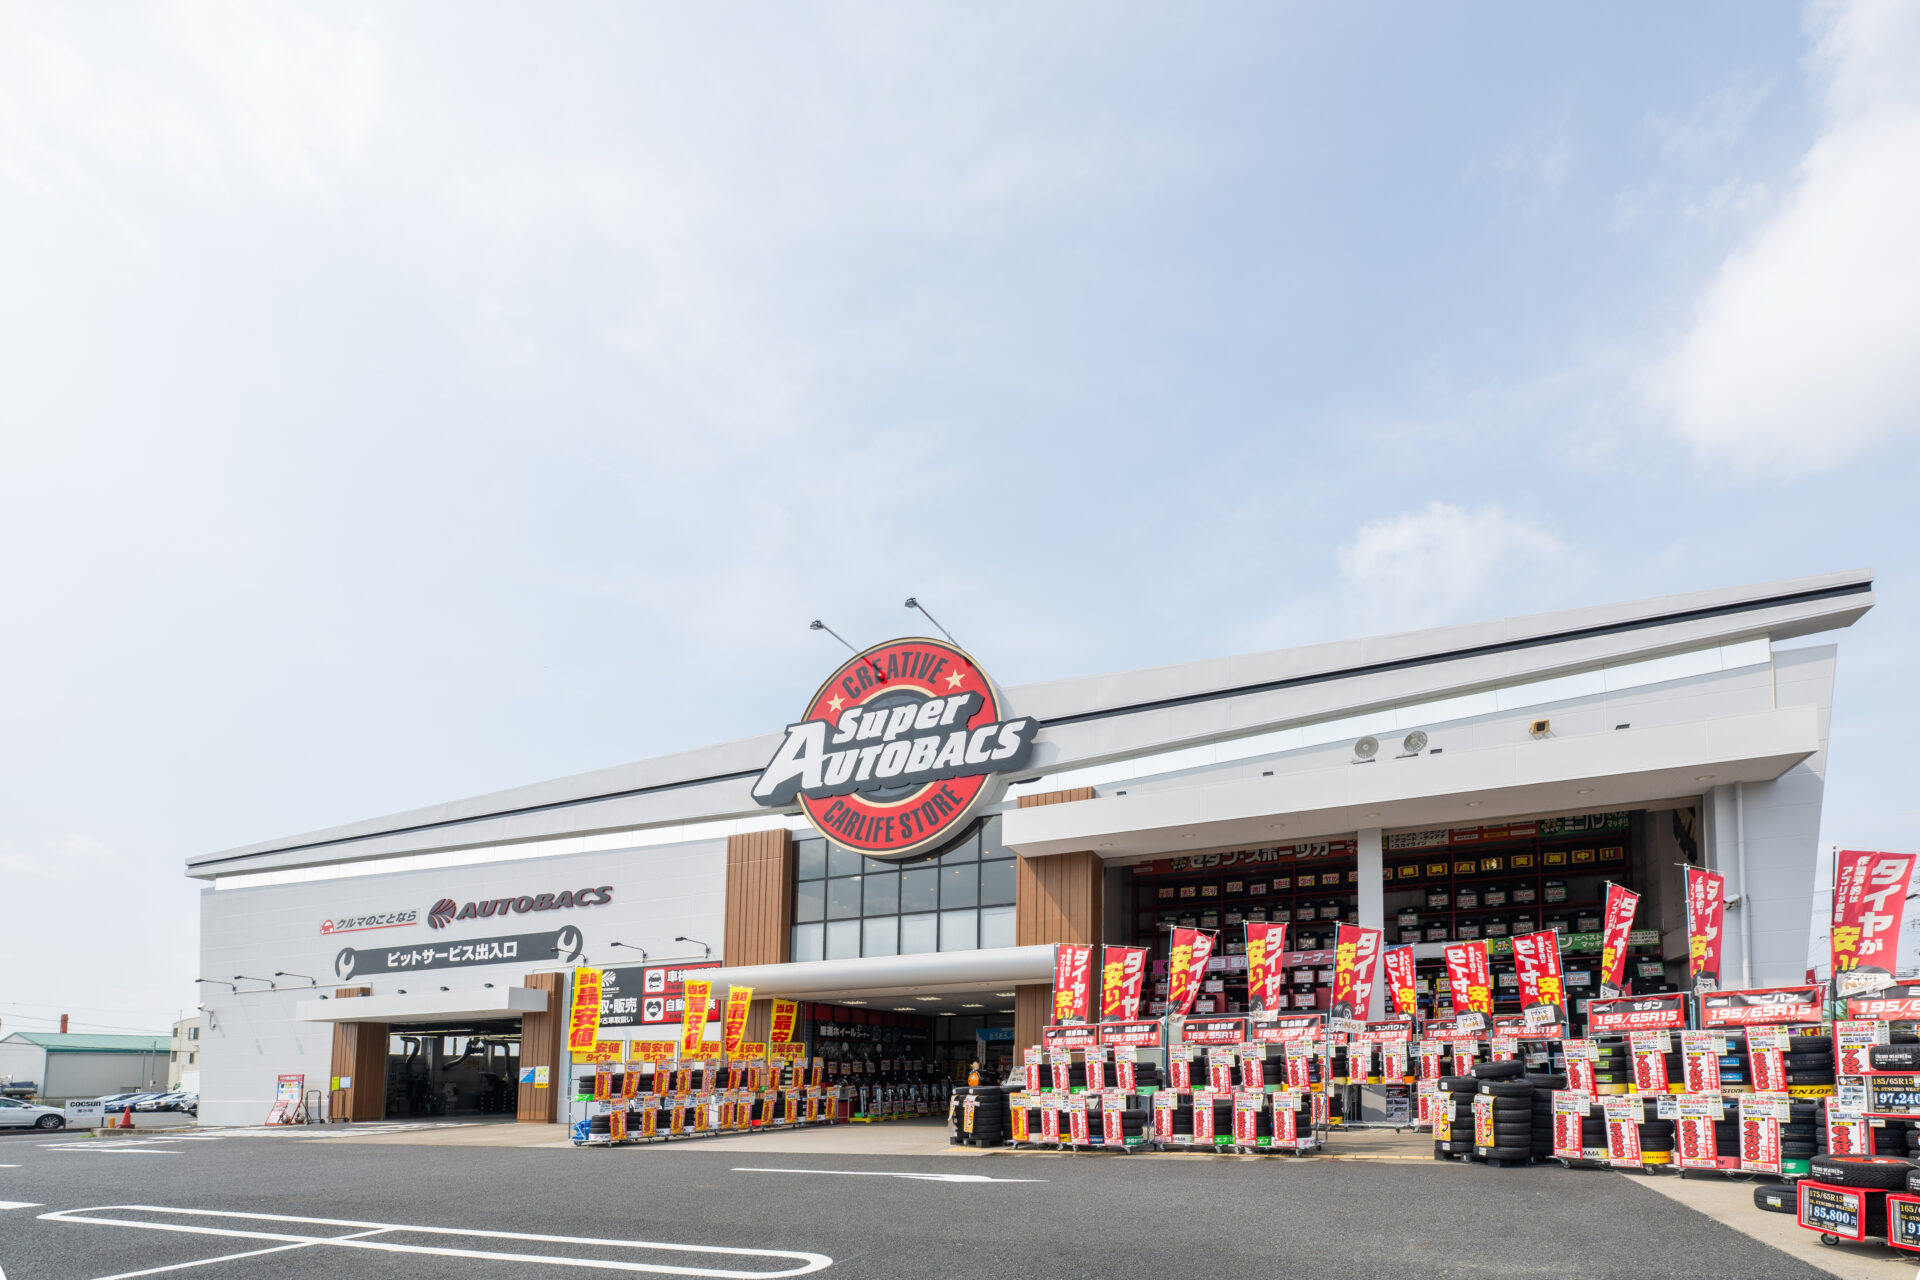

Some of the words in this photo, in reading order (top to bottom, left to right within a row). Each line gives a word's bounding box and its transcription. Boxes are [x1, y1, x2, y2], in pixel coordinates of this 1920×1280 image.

[842, 652, 949, 699] CREATIVE
[832, 693, 971, 744] Super
[752, 720, 1026, 797] AUTOBACS
[823, 800, 894, 842] CARLIFE
[900, 783, 963, 839] STORE
[336, 910, 417, 929] クルマのことなら
[456, 886, 613, 919] AUTOBACS
[1857, 859, 1909, 955] タイヤが
[1612, 897, 1636, 971] タイヤ
[1834, 926, 1861, 971] 安い!
[387, 942, 517, 967] ピットサービス出入口
[1170, 944, 1193, 1000] 安い!
[1265, 927, 1283, 1006] タイヤが
[1336, 942, 1357, 1000] 安い!
[1352, 932, 1377, 1015] タイヤが
[1070, 950, 1089, 1008] タイヤが
[1104, 962, 1124, 1015] 安い!
[570, 987, 599, 1047] 最安値
[600, 998, 637, 1014] 取・販売
[1056, 990, 1074, 1020] 安い!
[1598, 1011, 1678, 1025] 195/65R15
[1633, 1001, 1662, 1011] セダン
[1711, 1005, 1812, 1020] 195/65R15
[1105, 1033, 1156, 1043] 155/65R14
[1188, 1031, 1241, 1039] 165/55R15
[1259, 1028, 1316, 1037] 165/55R15
[1873, 1077, 1914, 1085] 185/65R15
[1809, 1190, 1844, 1203] 175/65R15
[1813, 1206, 1850, 1224] 85,800
